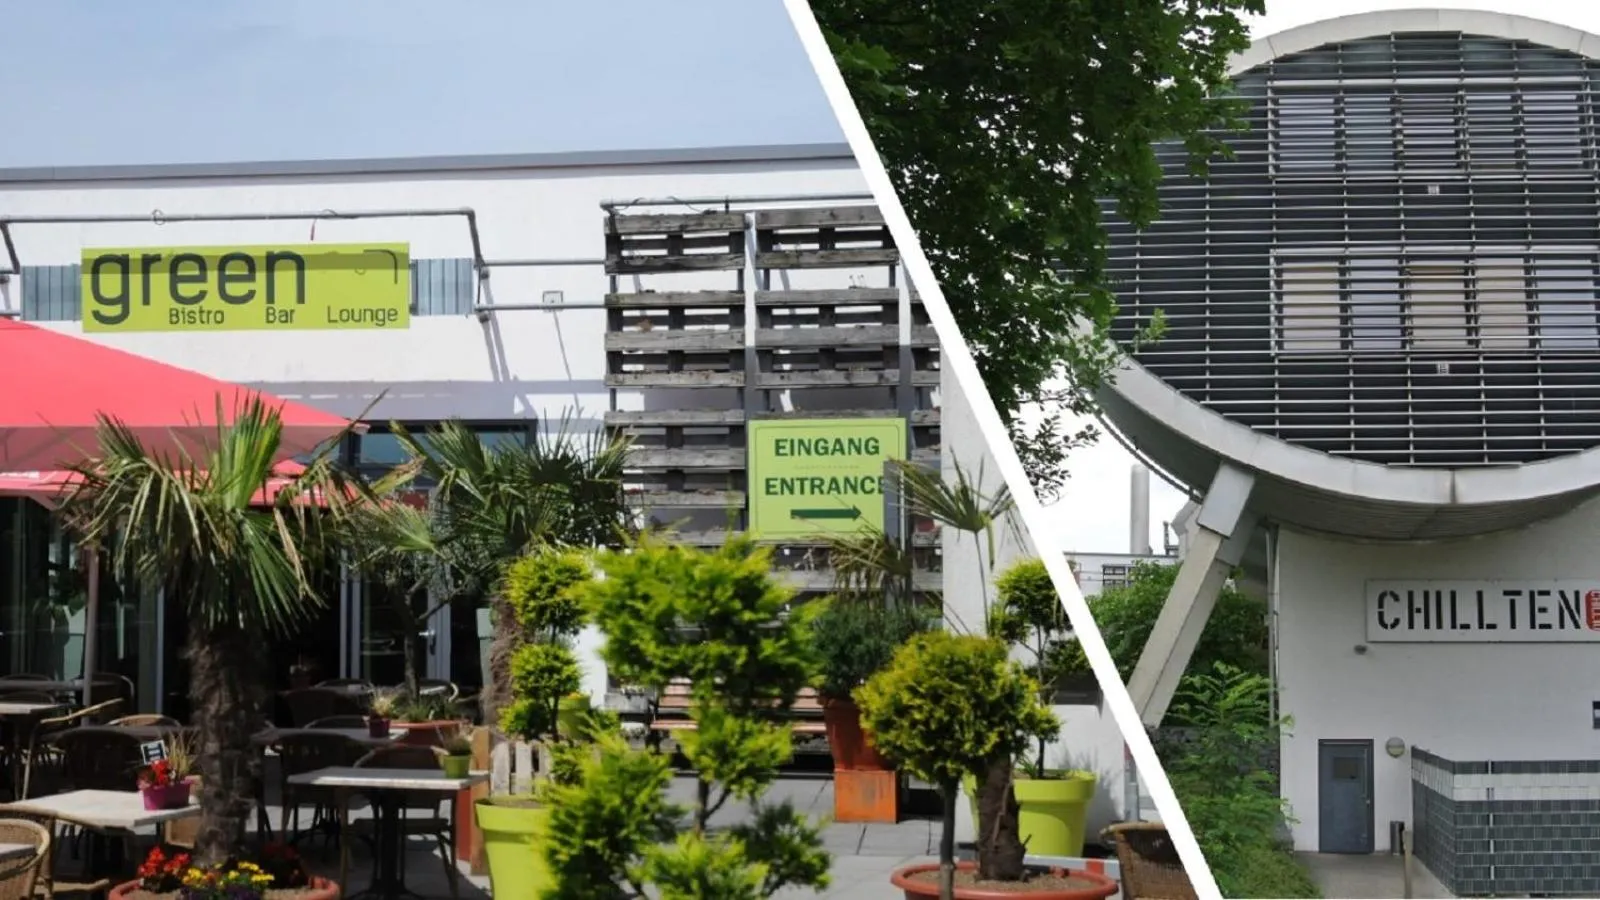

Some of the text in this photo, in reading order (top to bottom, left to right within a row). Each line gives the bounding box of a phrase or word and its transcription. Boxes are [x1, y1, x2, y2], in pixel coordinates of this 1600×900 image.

[90, 250, 305, 326] green
[168, 305, 398, 327] Bistro Bar Lounge
[774, 437, 880, 457] EINGANG
